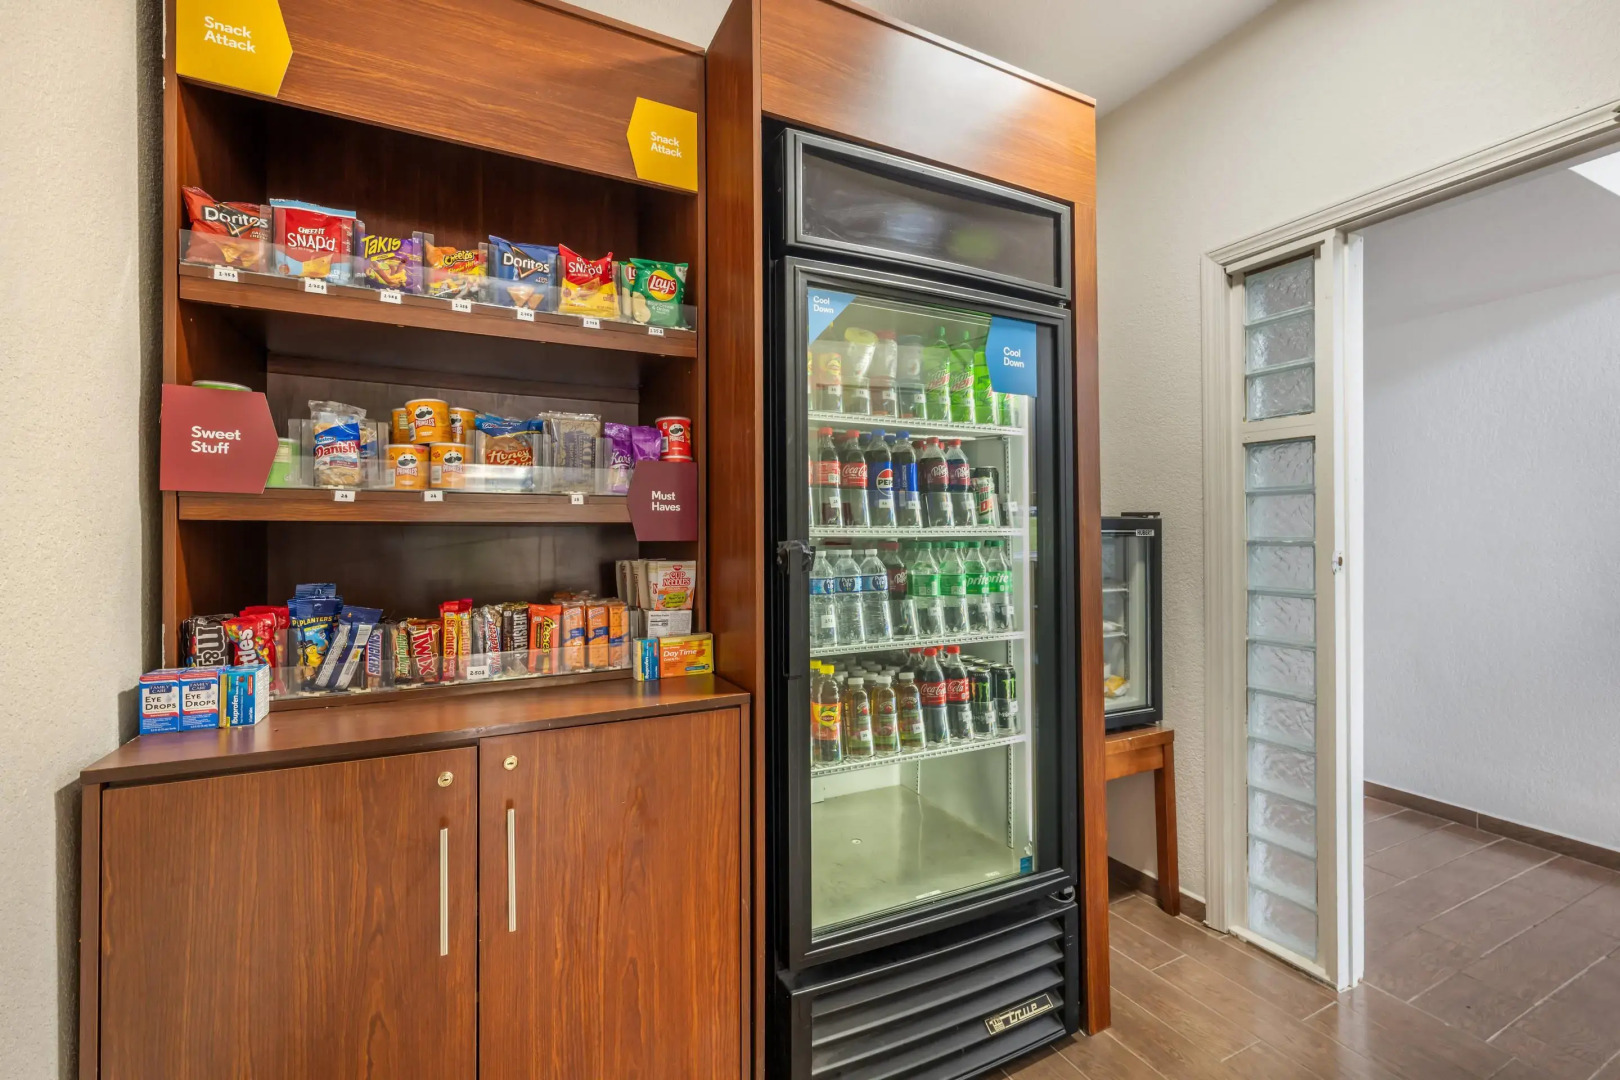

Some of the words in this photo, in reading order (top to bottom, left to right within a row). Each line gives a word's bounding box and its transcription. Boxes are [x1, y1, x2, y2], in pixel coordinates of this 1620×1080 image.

[204, 15, 252, 39] Snack
[204, 30, 256, 54] Attack
[650, 131, 680, 148] Snack
[650, 142, 682, 158] Attack
[204, 207, 268, 228] Doritos
[443, 251, 473, 266] Cheetos
[503, 252, 550, 273] Doritos
[650, 275, 676, 294] Lay's
[814, 296, 830, 305] Cool
[814, 304, 834, 314] Down
[1004, 347, 1021, 358] Cool
[1004, 358, 1024, 368] Down
[415, 419, 435, 428] PRINGLES
[191, 426, 241, 440] Sweet
[191, 440, 229, 454] Stuff
[316, 442, 356, 459] Danish
[488, 448, 531, 463] Honey
[612, 452, 631, 464] Kar's
[397, 468, 418, 476] PRINGLES
[652, 491, 676, 500] Must
[652, 502, 681, 511] Haves
[662, 578, 691, 586] NOODLES
[670, 571, 686, 579] CUP
[300, 616, 332, 627] PLANTERS
[542, 616, 556, 654] Reese's
[368, 634, 380, 674] SNICKERS
[664, 650, 678, 658] Day
